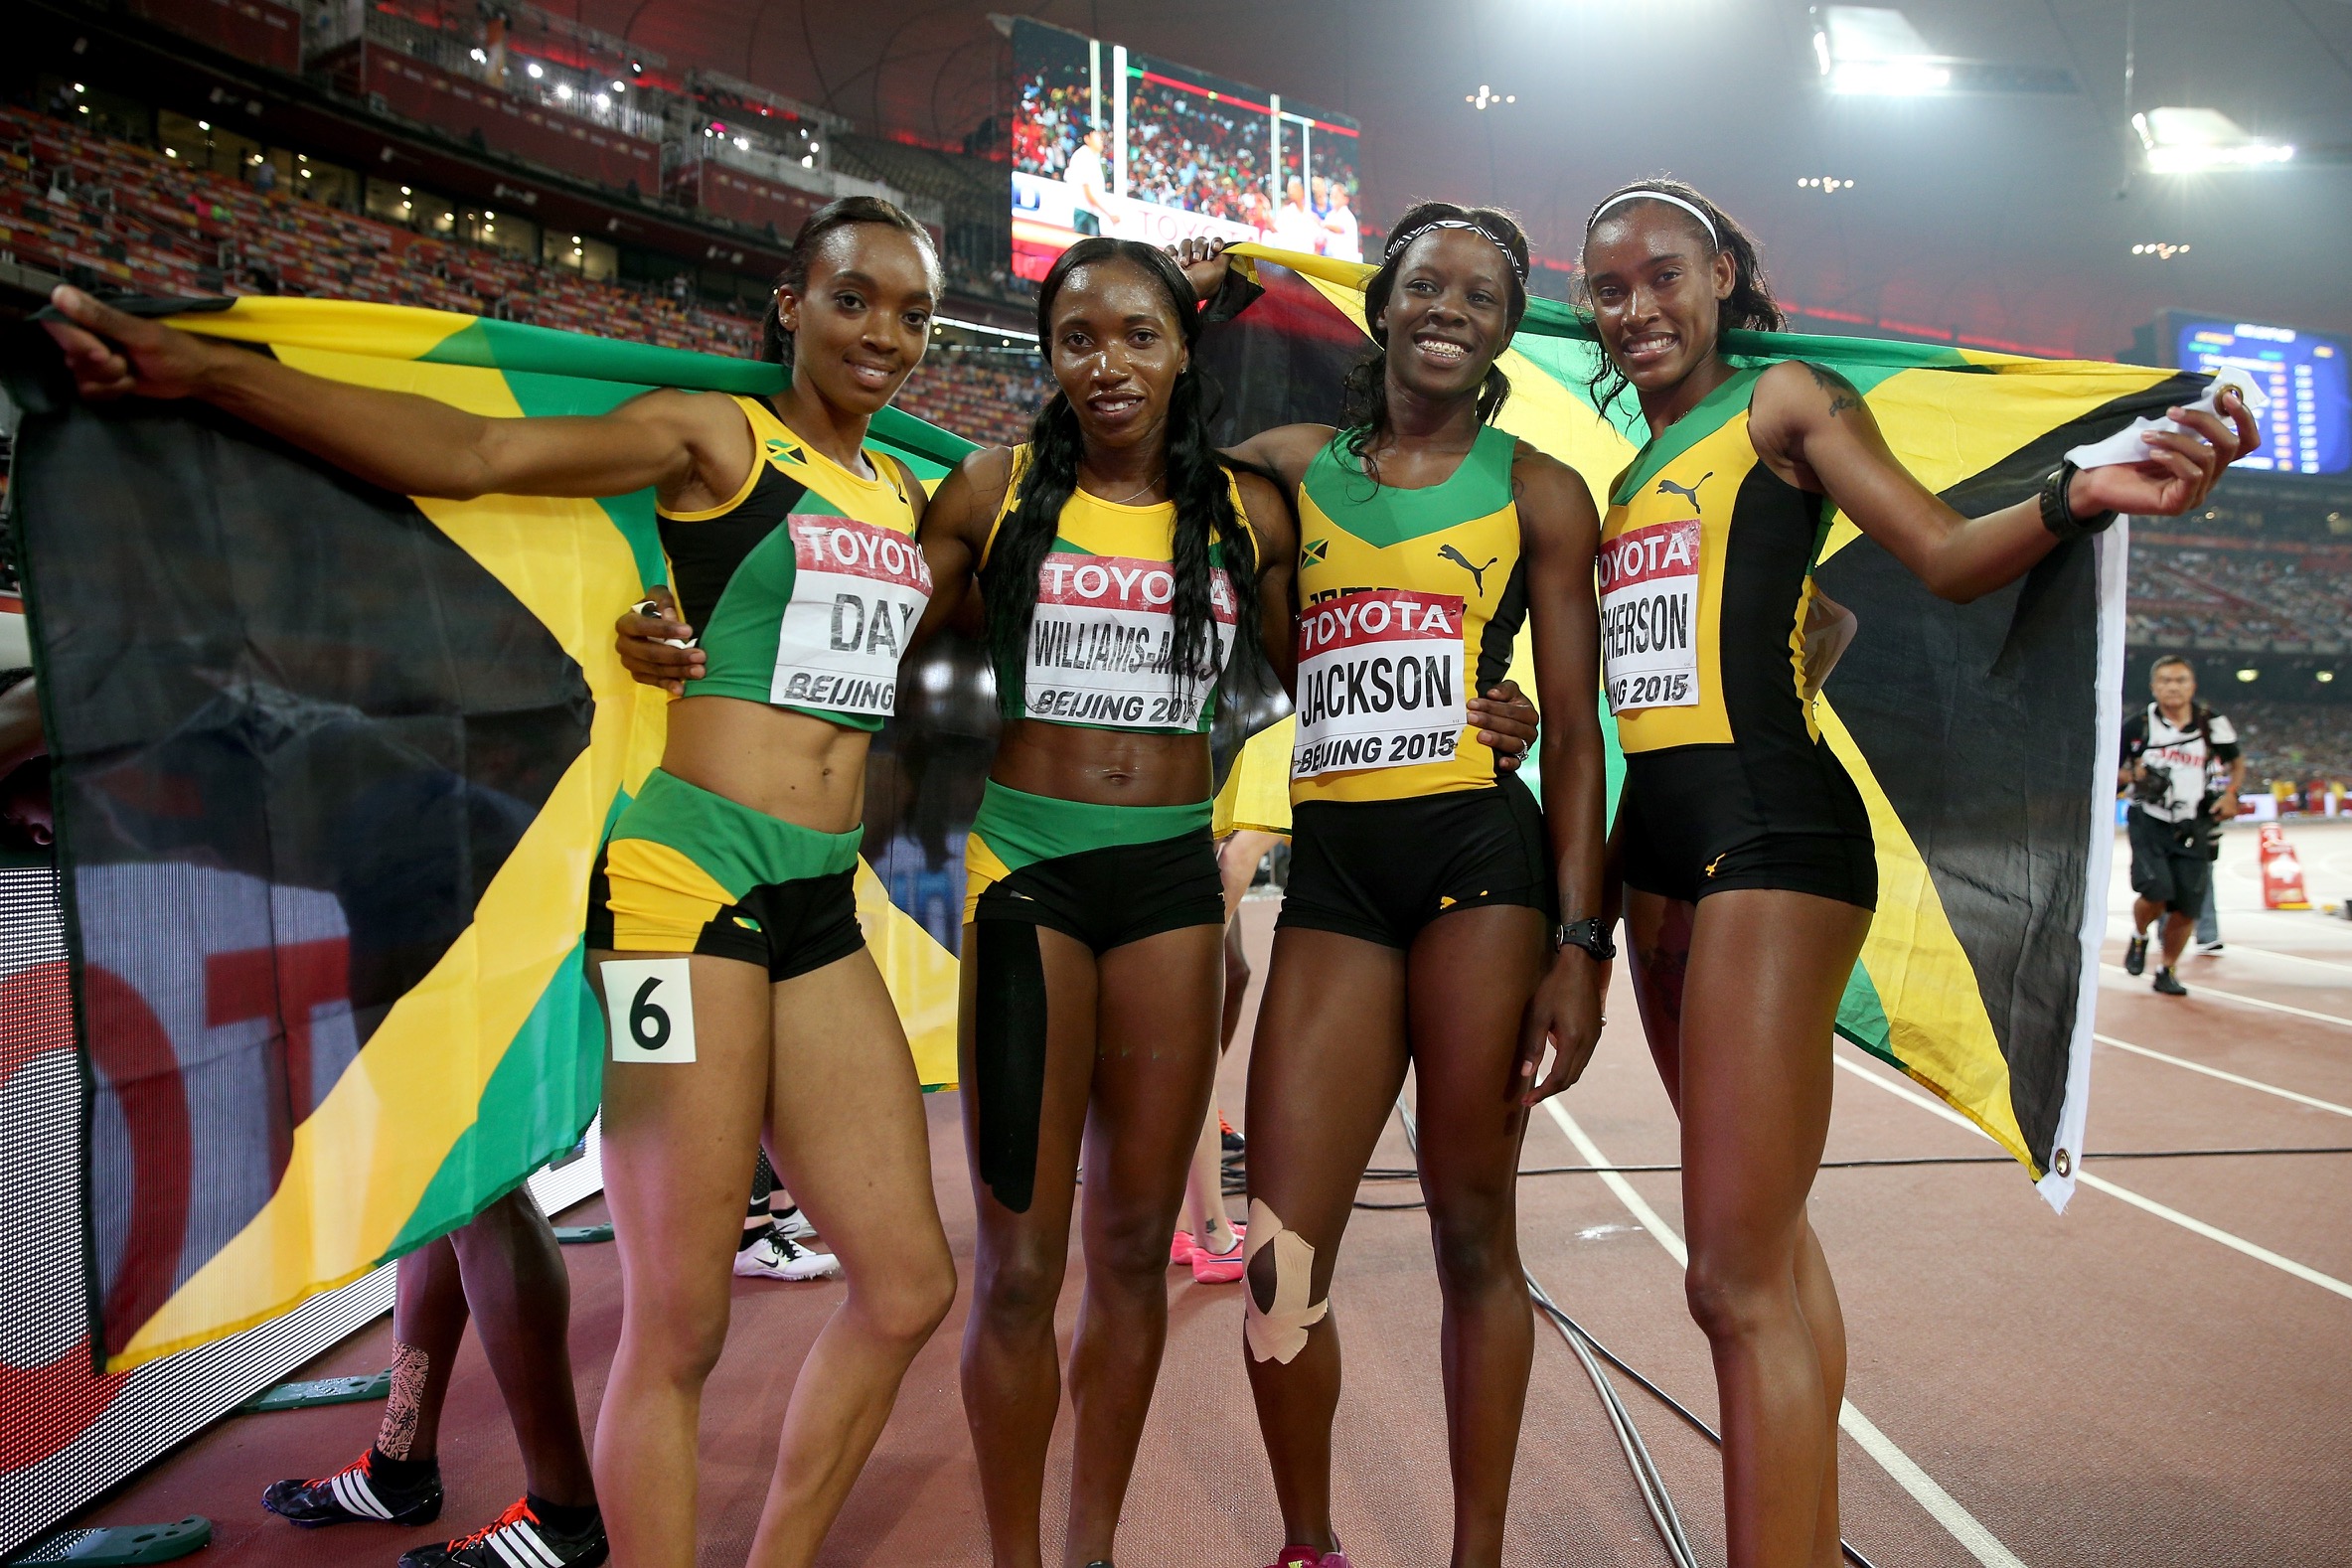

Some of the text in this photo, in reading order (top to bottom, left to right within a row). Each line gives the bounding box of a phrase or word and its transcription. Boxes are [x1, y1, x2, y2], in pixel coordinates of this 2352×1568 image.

[1044, 561, 1232, 615] TOYOA
[830, 593, 914, 658] DAY
[1301, 600, 1454, 651] TOYOTA
[783, 672, 894, 709] BEIJING
[1035, 690, 1144, 721] BEIJING
[1302, 655, 1453, 727] JACKSON
[1630, 674, 1689, 704] 2015
[1297, 730, 1458, 774] BEIJING 2015
[629, 976, 672, 1051] 6
